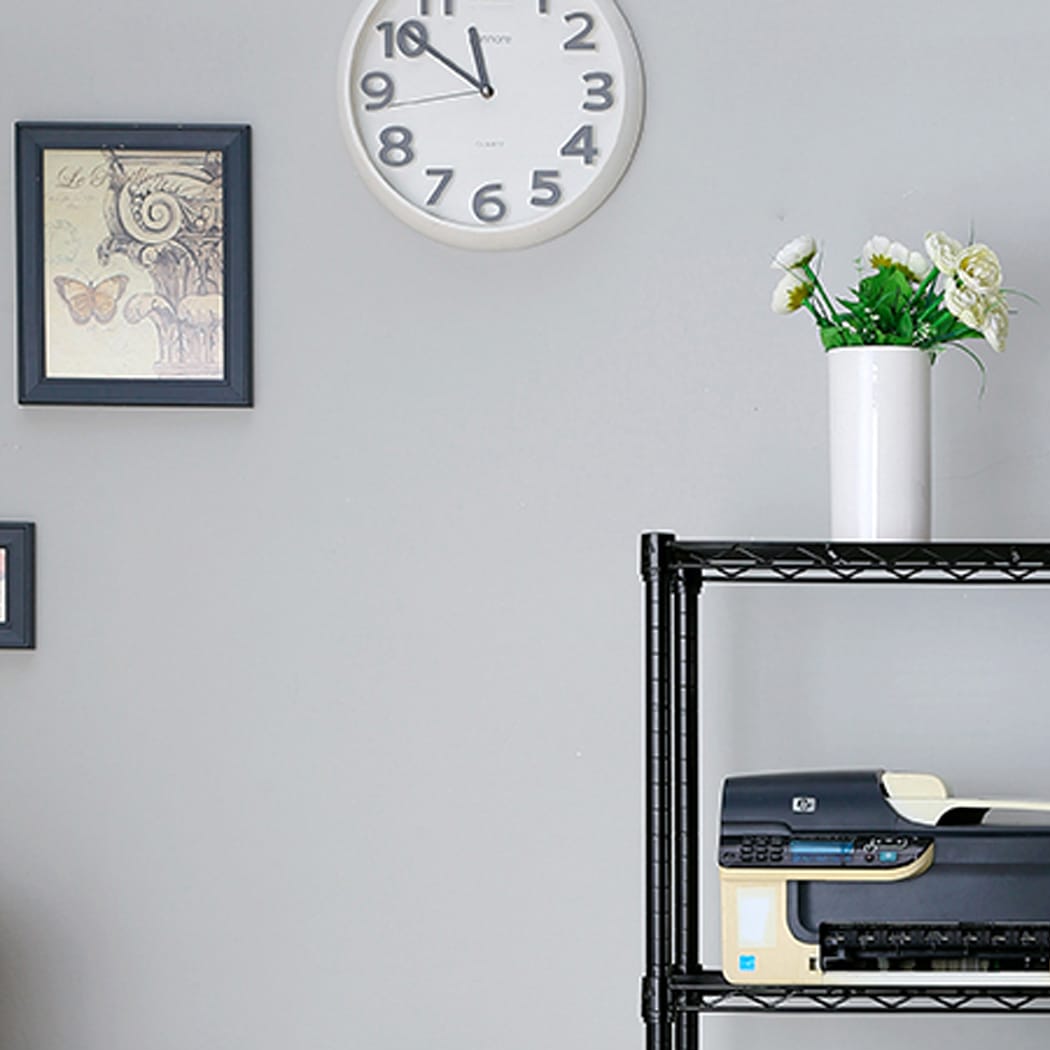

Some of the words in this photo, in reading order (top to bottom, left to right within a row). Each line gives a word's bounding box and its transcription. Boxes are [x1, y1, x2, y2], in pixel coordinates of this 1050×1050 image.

[376, 19, 429, 58] 10
[563, 11, 597, 51] 2
[360, 71, 395, 111] 9
[582, 71, 614, 112] 3
[378, 125, 415, 167] 8
[559, 125, 599, 165] 4
[424, 168, 454, 206] 7
[472, 183, 507, 223] 6
[529, 169, 562, 207] 5
